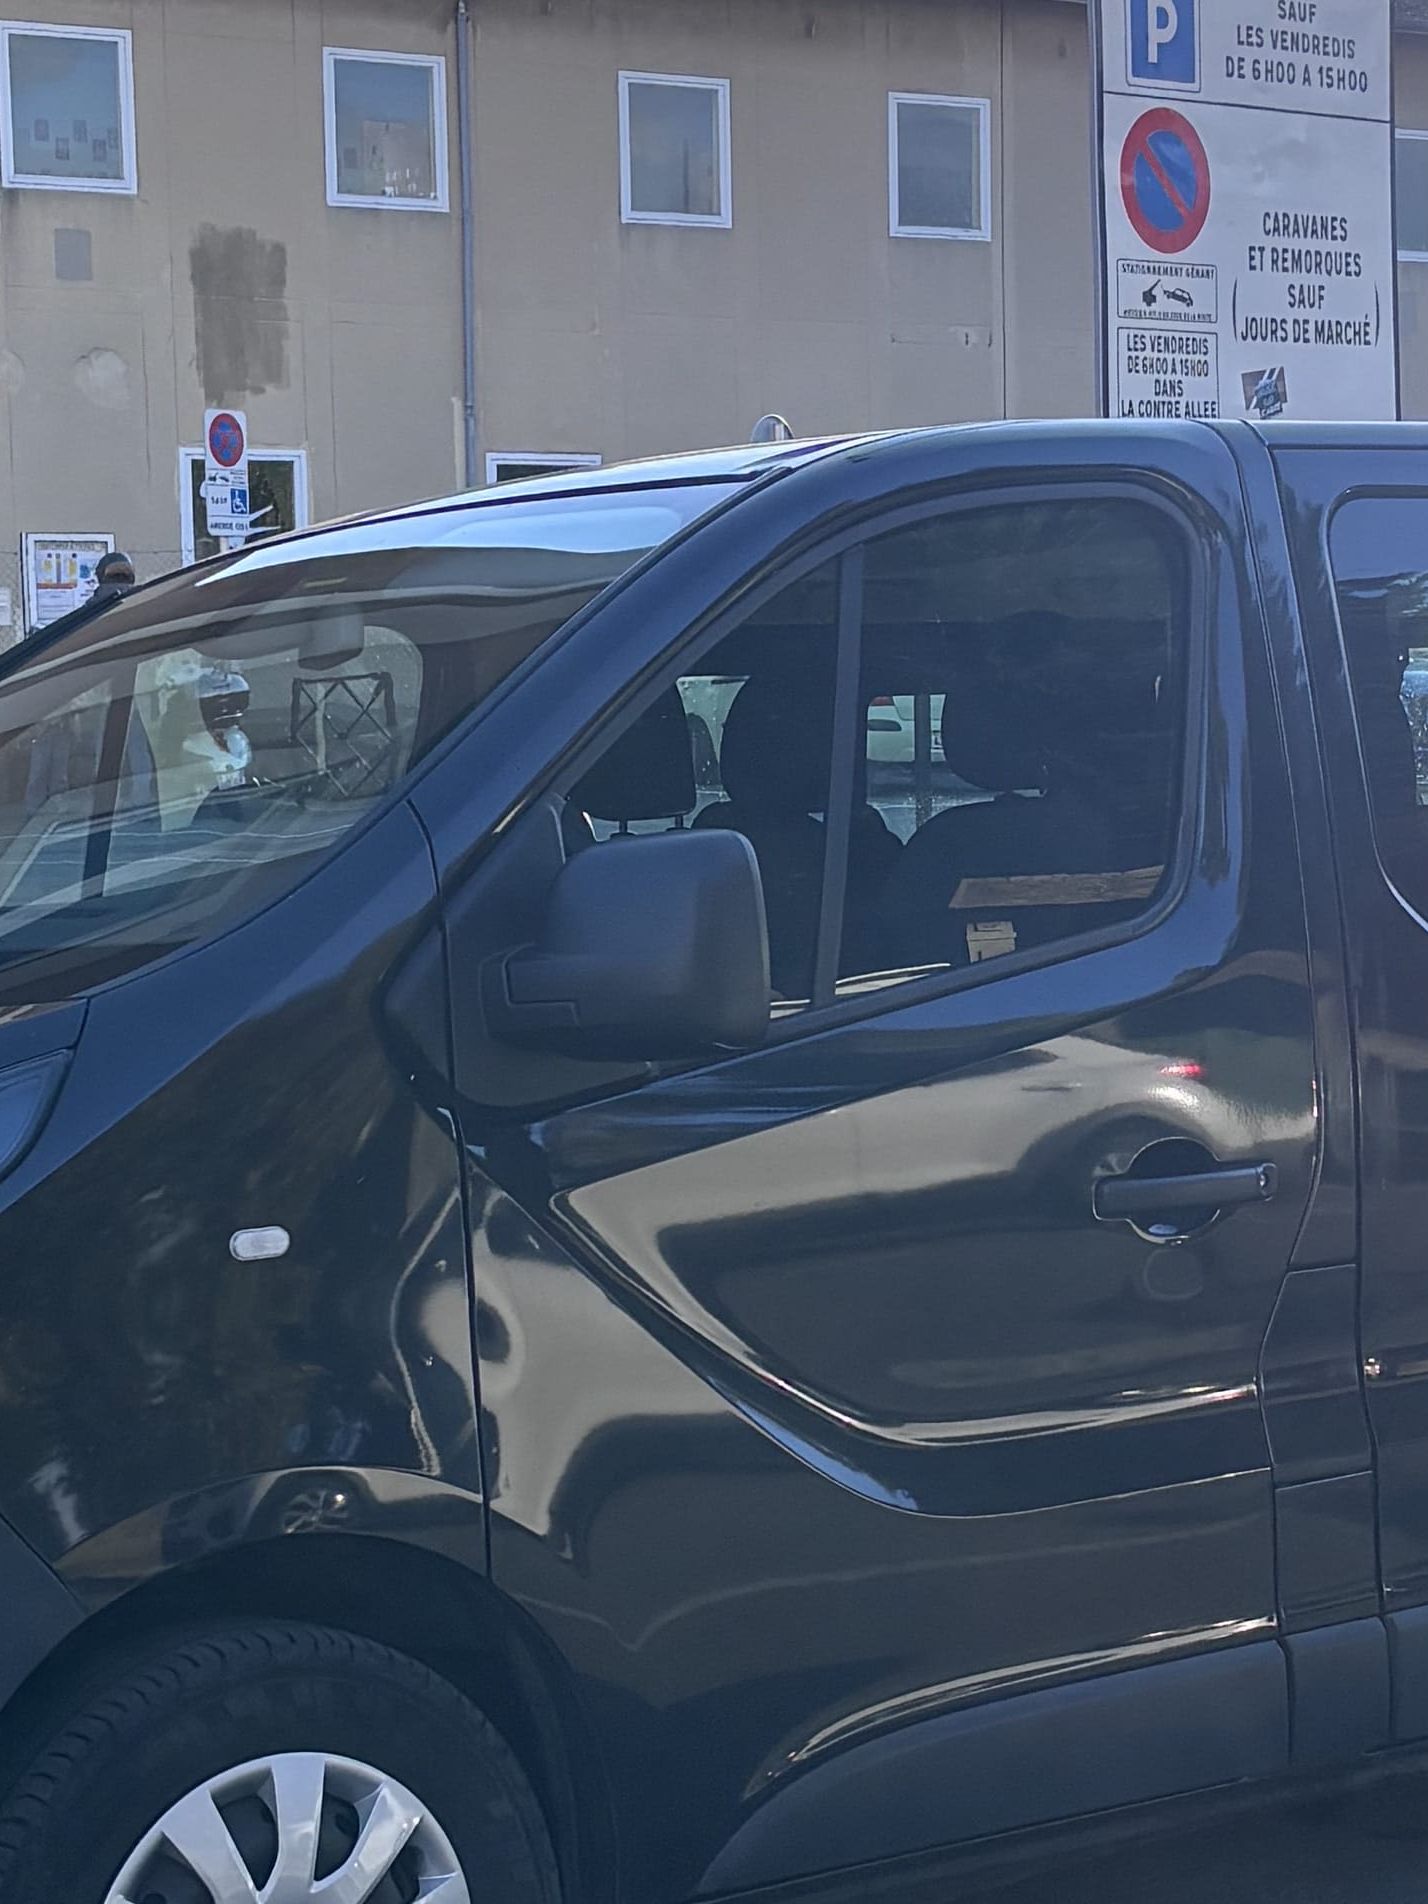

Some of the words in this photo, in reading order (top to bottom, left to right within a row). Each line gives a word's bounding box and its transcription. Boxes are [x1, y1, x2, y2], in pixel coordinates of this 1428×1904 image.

[1277, 0, 1317, 24] SAUF
[1237, 24, 1264, 48] LES
[1270, 28, 1356, 59] VENDREDIS
[1225, 55, 1246, 80] DE
[1302, 63, 1312, 87] A
[1317, 65, 1368, 93] 15H00
[1262, 211, 1348, 242] CARAVANES
[1248, 246, 1265, 272] ET
[1271, 247, 1362, 278] REMORQUES
[1287, 283, 1326, 310] SAUF
[1241, 316, 1289, 343] JOURS
[1293, 319, 1311, 344] DE
[1314, 313, 1372, 346] MARCHÉ
[1127, 333, 1146, 352] LES
[1150, 334, 1209, 356] VENDREDIS
[1127, 355, 1140, 374] DE
[1141, 356, 1168, 376] 6H00
[1171, 357, 1177, 375] A
[1180, 359, 1209, 377] 15H00
[1154, 378, 1184, 398] DANS
[1122, 399, 1134, 418] LA
[1138, 400, 1181, 419] CONTRE
[1184, 400, 1217, 419] ALLEE
